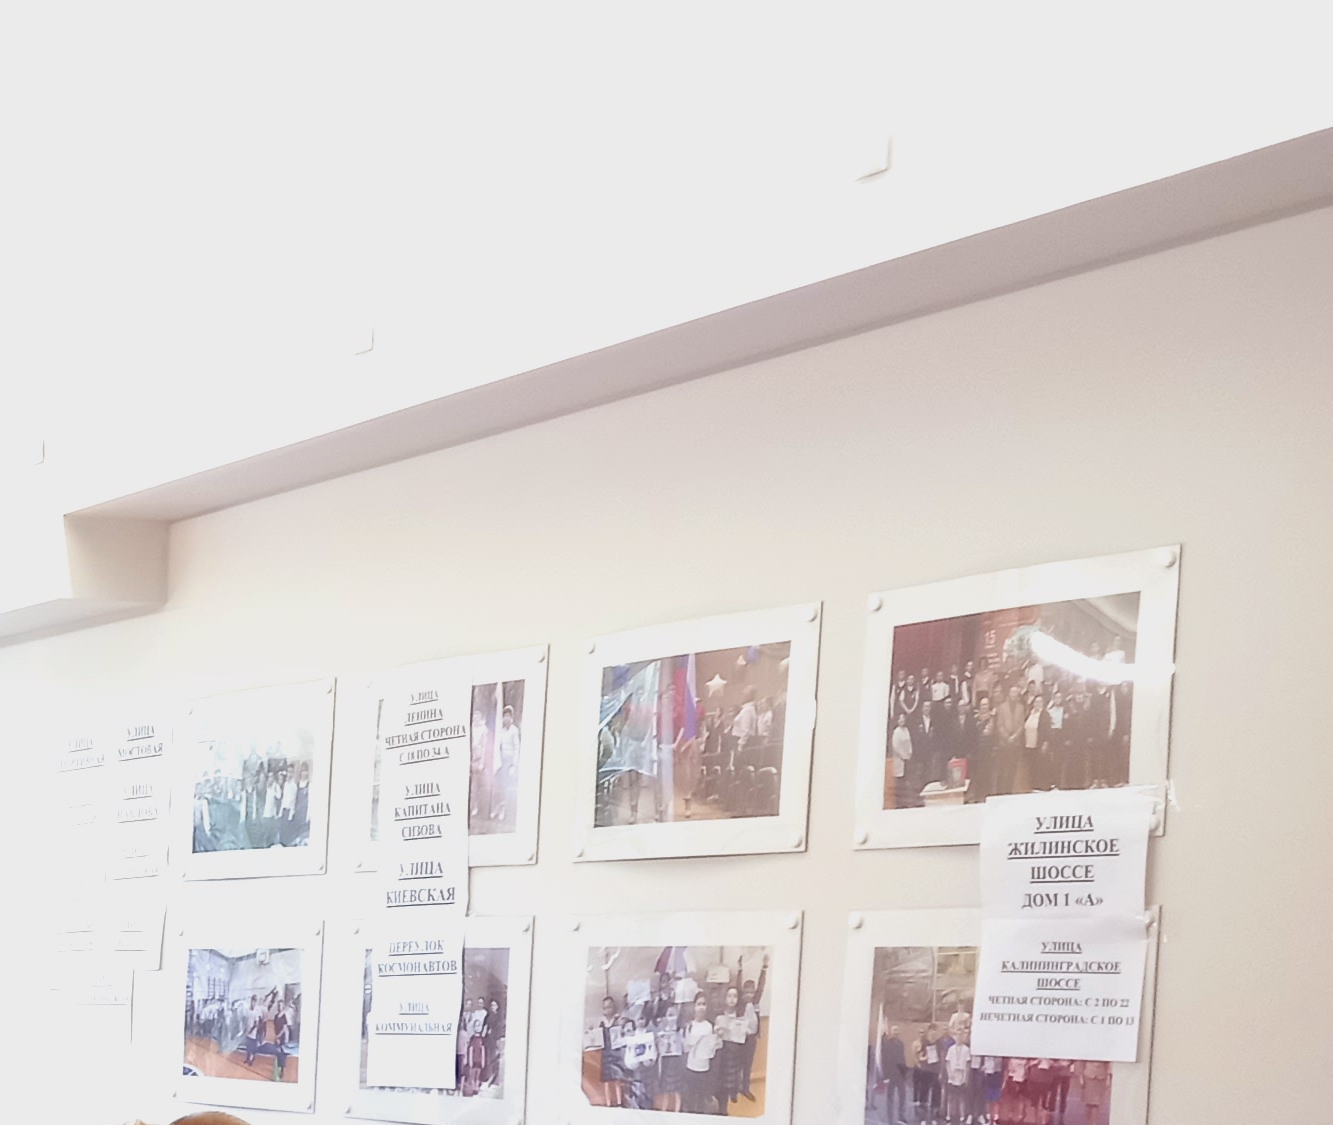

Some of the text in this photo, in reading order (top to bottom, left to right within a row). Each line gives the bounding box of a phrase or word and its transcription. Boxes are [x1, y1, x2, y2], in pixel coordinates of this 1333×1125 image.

[410, 690, 438, 702] УЛИЦА
[404, 708, 443, 723] ЛЕНИНА
[385, 725, 466, 746] ЧЕТНАЯ СТОРОНА
[417, 749, 430, 759] ПО
[405, 782, 441, 796] УЛИЦА
[394, 802, 451, 818] КАПИТАНА
[1034, 814, 1094, 831] УЛИЦА
[1007, 838, 1120, 856] ЖИЛИНСКОЕ
[399, 861, 443, 877] УЛИЦА
[1030, 864, 1094, 880] ШОССЕ
[386, 887, 456, 905] КИЕВСКАЯ
[1022, 893, 1104, 909] ДОМ 1 «А»
[389, 939, 444, 954] ПЕРЕУЛОК
[1041, 941, 1082, 953] УЛИЦА
[377, 959, 458, 975] КОСМОНАВТОВ
[1001, 960, 1122, 972] КАЛИНИНГРАДСКОЕ
[1036, 978, 1081, 989] ШОССЕ
[988, 996, 1028, 1005] ЧЕТНАЯ
[1030, 997, 1083, 1006] СТОРОНА:
[1084, 998, 1092, 1006] С
[1102, 998, 1118, 1007] ПО
[1120, 999, 1130, 1008] 22
[980, 1013, 1034, 1022] НЕЧЕТНАЯ
[1036, 1014, 1088, 1024] СТОРОНА:
[1091, 1016, 1099, 1024] С
[1108, 1016, 1123, 1025] ПО
[375, 1023, 452, 1033] КОММУНАЛЬНАЯ
